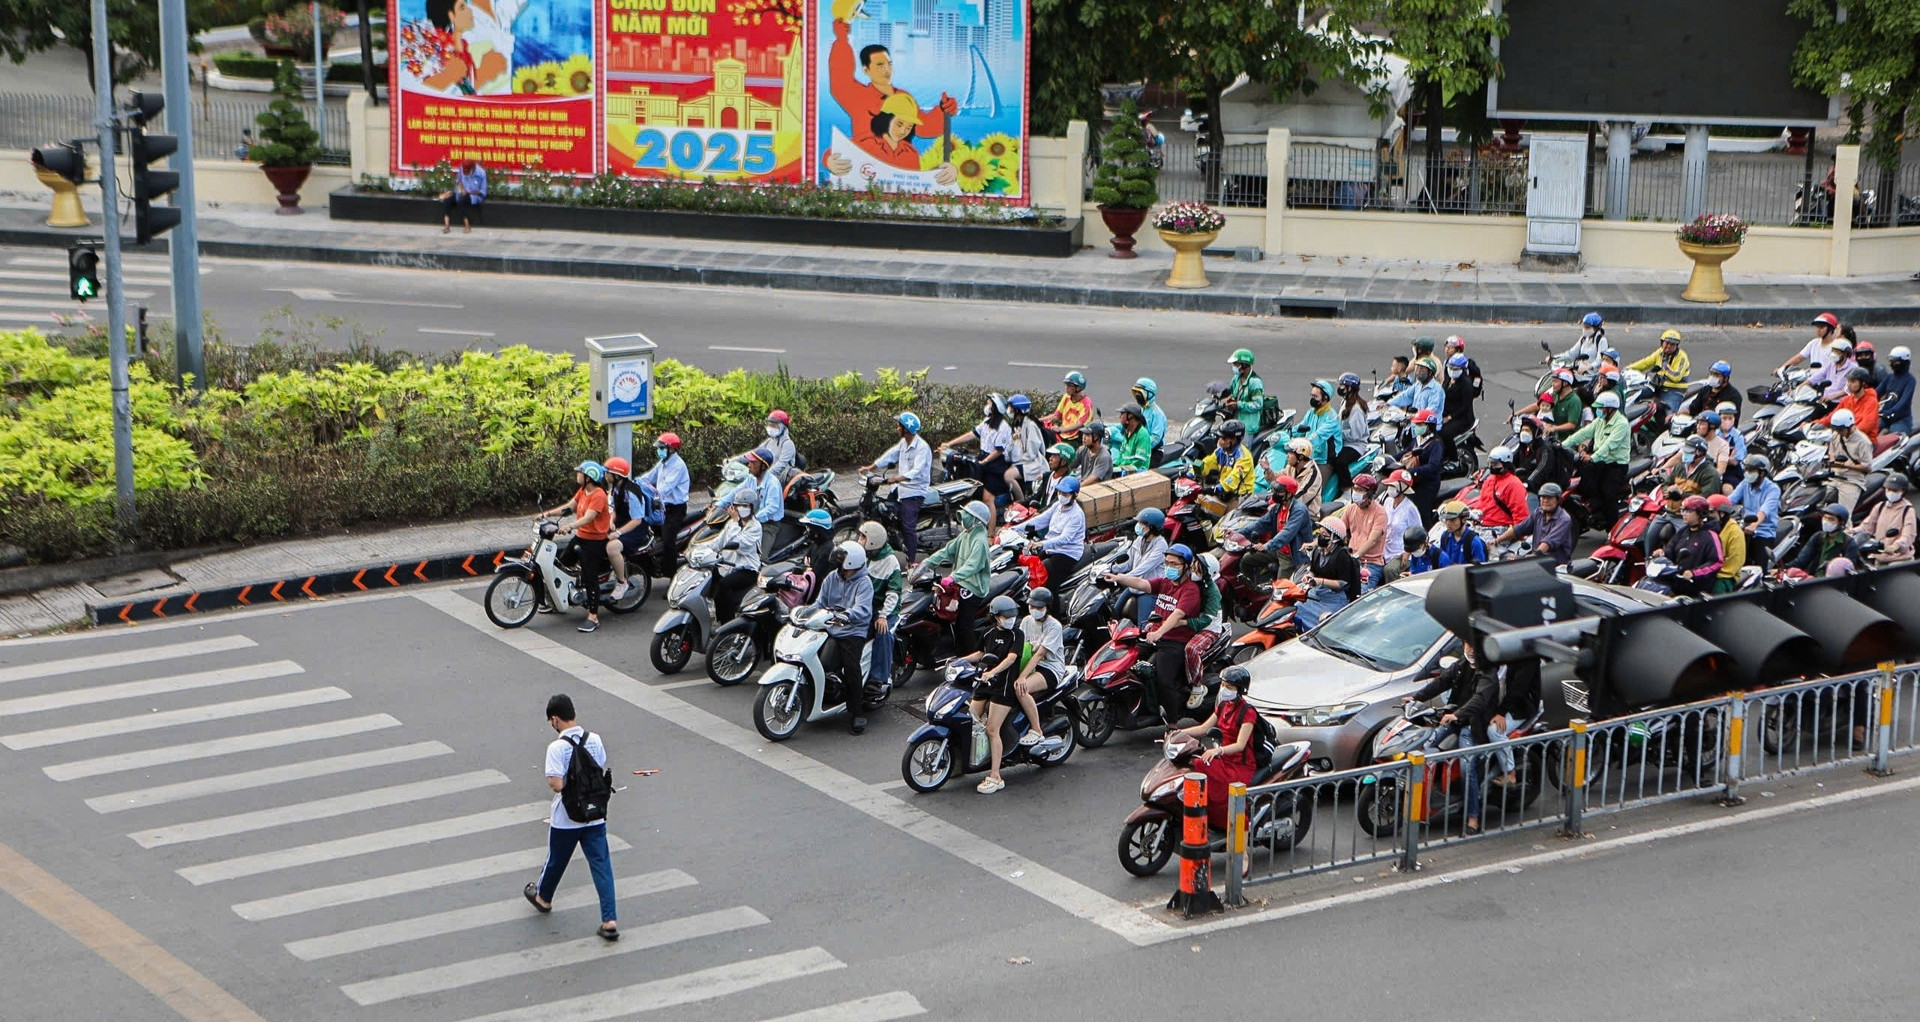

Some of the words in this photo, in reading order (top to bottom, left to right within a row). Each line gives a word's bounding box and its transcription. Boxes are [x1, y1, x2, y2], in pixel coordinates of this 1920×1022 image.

[612, 12, 661, 34] NĂM
[667, 14, 708, 36] MỚI
[633, 128, 777, 175] 2025
